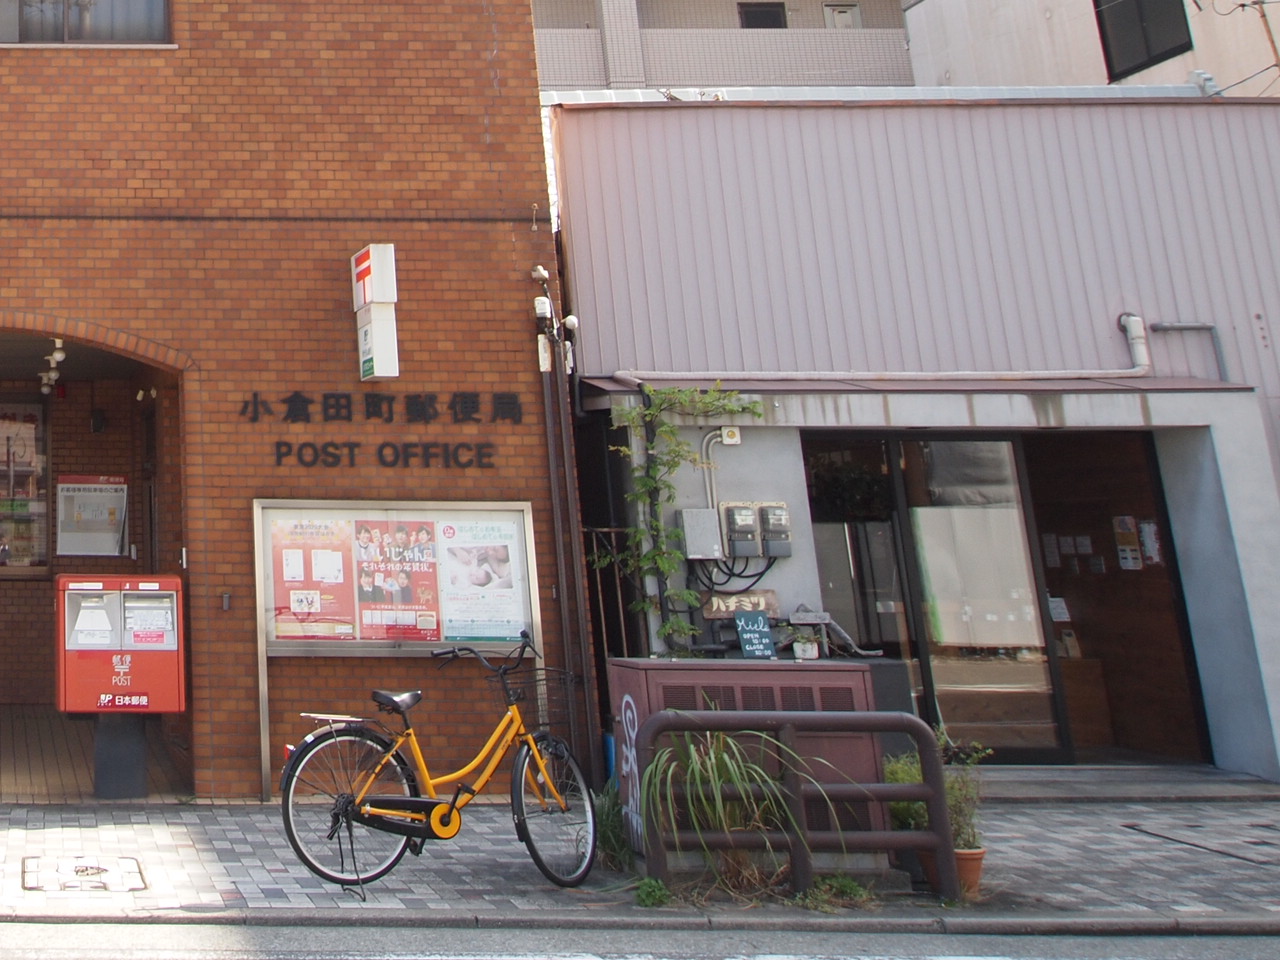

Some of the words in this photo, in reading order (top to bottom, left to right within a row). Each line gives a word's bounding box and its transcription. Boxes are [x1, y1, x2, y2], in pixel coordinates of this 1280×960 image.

[239, 391, 523, 424] 小倉田町郵便局
[275, 441, 360, 468] POST
[377, 441, 495, 468] OFFICE
[711, 596, 766, 612] ハチミツ
[112, 654, 131, 666] 郵便
[112, 675, 131, 686] POST
[115, 696, 148, 706] 日本郵便
